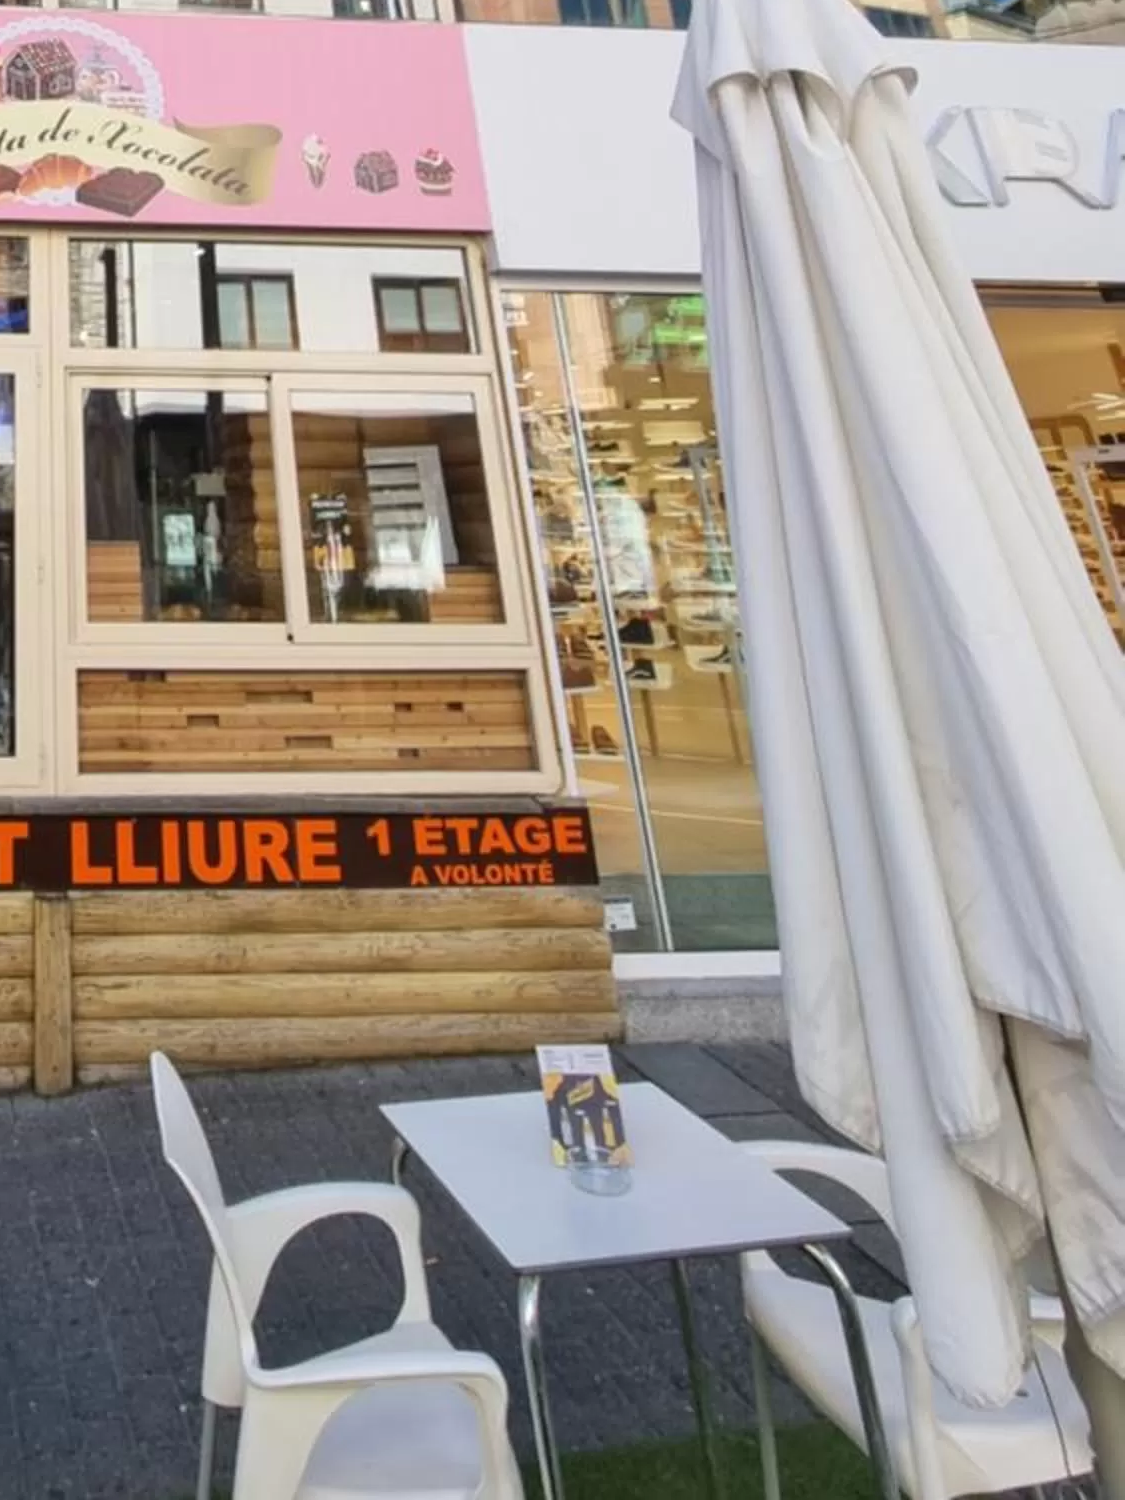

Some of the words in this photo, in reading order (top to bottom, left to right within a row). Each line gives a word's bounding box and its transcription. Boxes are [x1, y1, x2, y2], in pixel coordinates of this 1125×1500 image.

[38, 107, 80, 144] de
[87, 119, 253, 198] Xocolata
[70, 818, 343, 885] LLIURE
[365, 818, 391, 857] 1
[410, 866, 430, 886] A
[434, 860, 555, 885] VOLONTÉ
